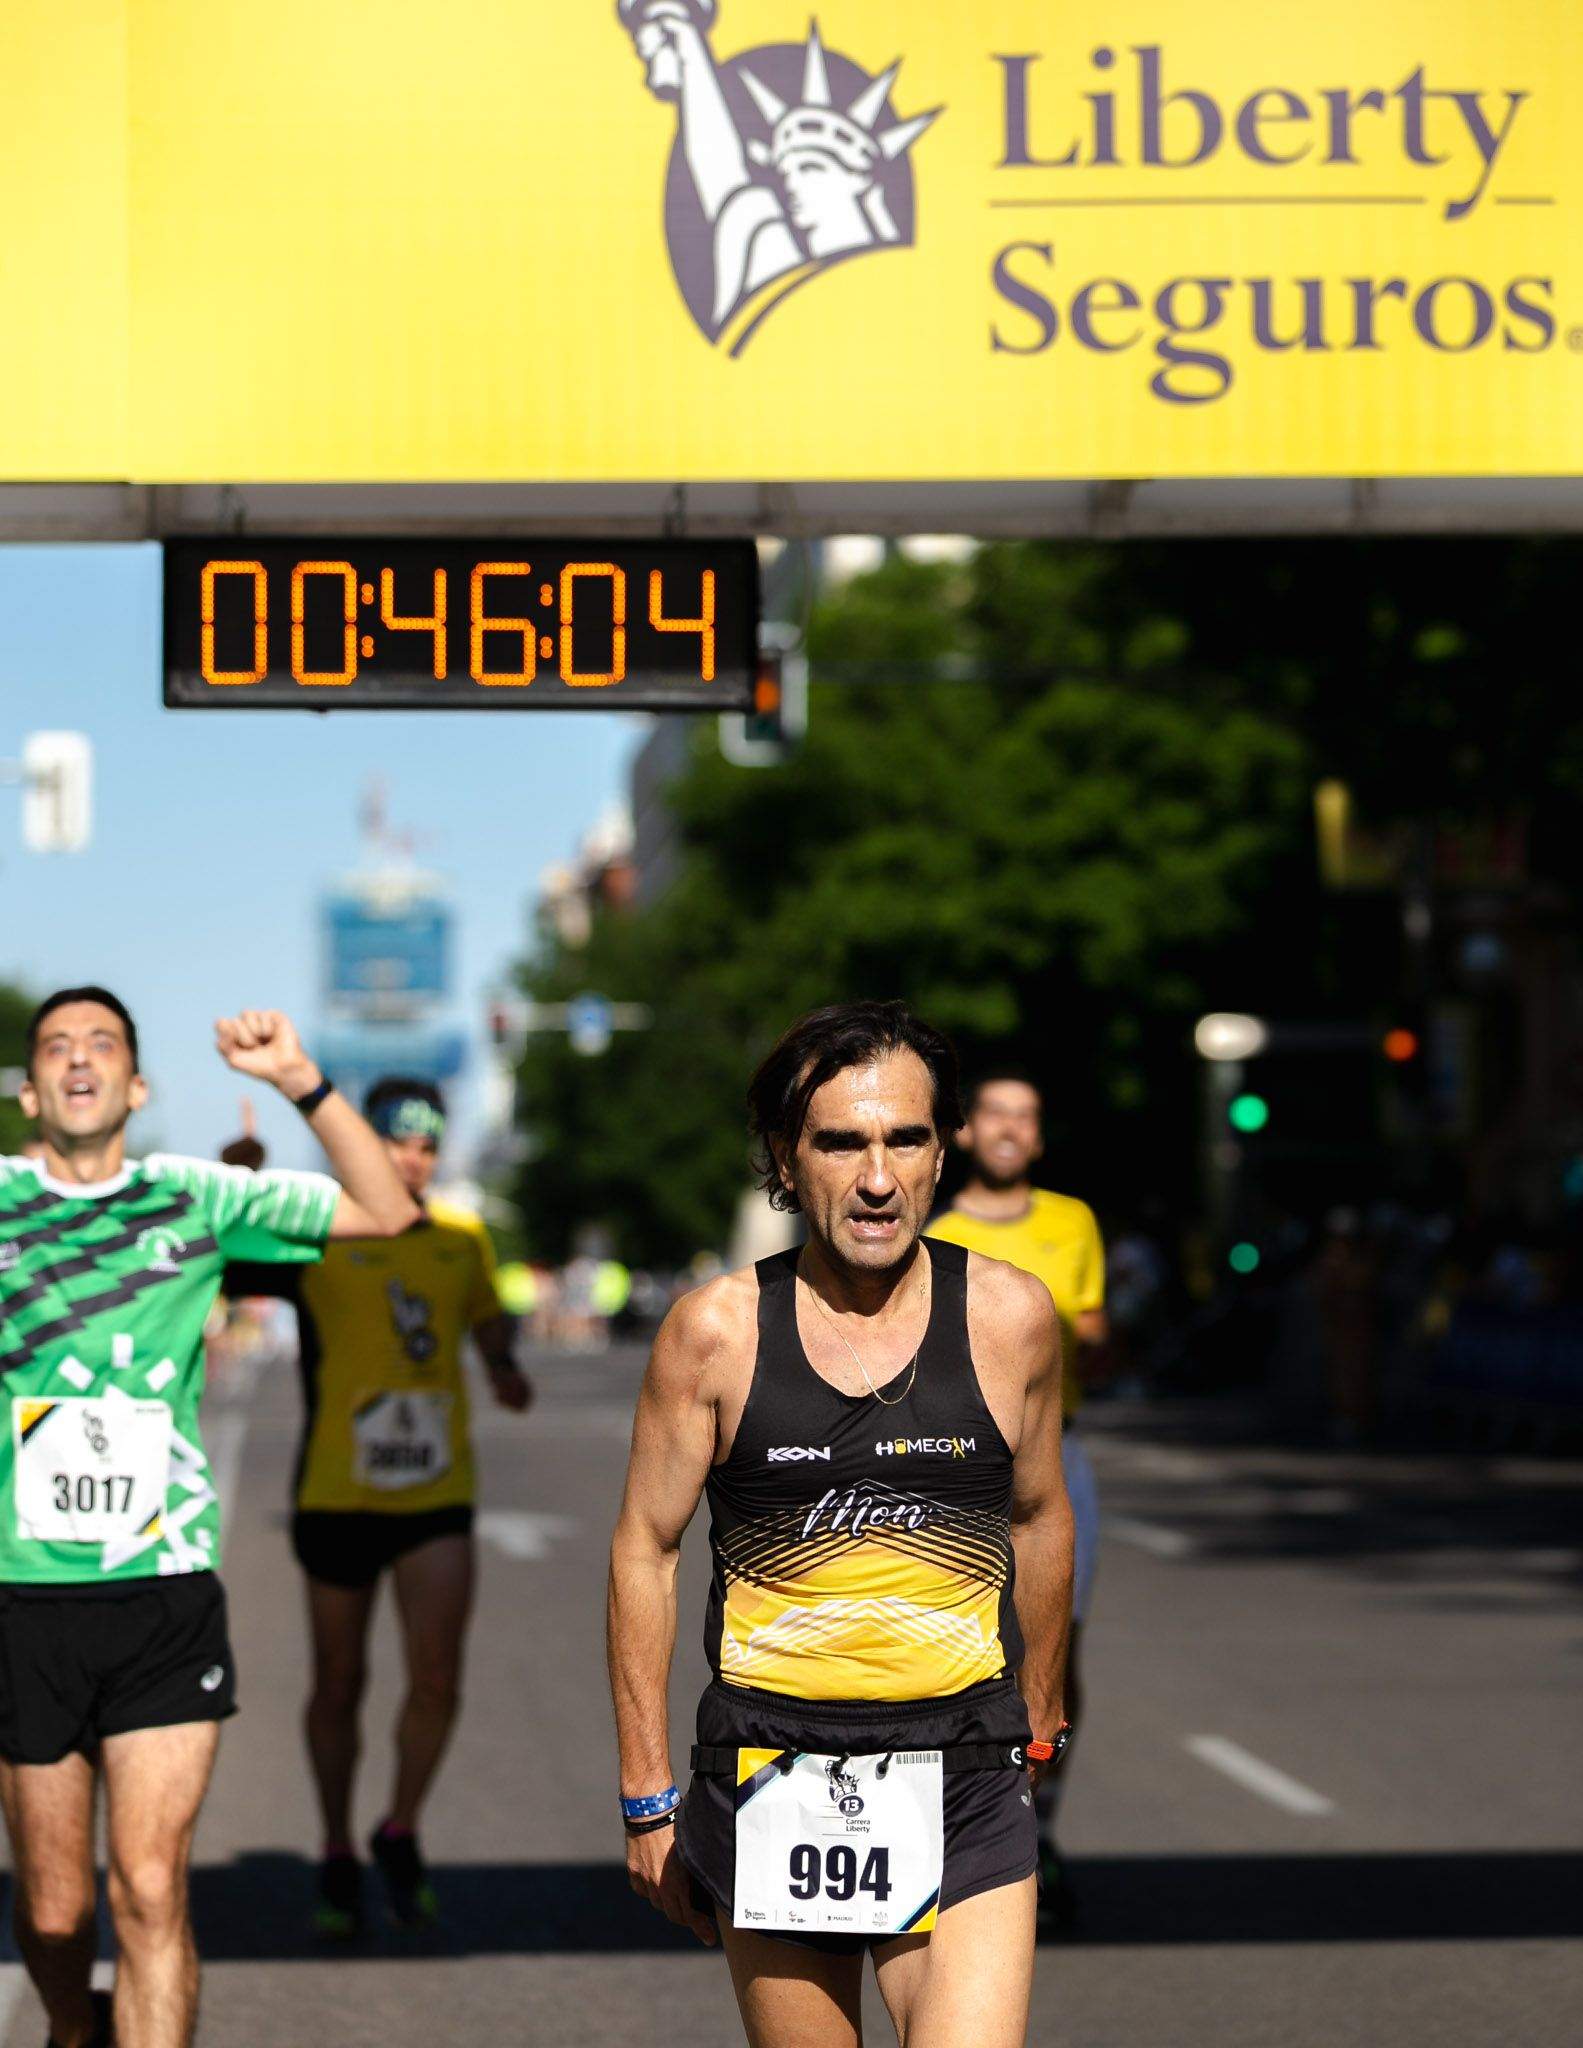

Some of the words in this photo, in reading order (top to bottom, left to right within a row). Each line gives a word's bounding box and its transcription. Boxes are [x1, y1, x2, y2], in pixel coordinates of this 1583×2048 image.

[990, 45, 1531, 220] Liberty
[988, 242, 1556, 404] Seguros
[201, 560, 716, 686] 00:46:04
[53, 1474, 135, 1513] 3017
[843, 1799, 860, 1812] 13
[845, 1825, 871, 1833] Liberty
[788, 1843, 892, 1902] 994
